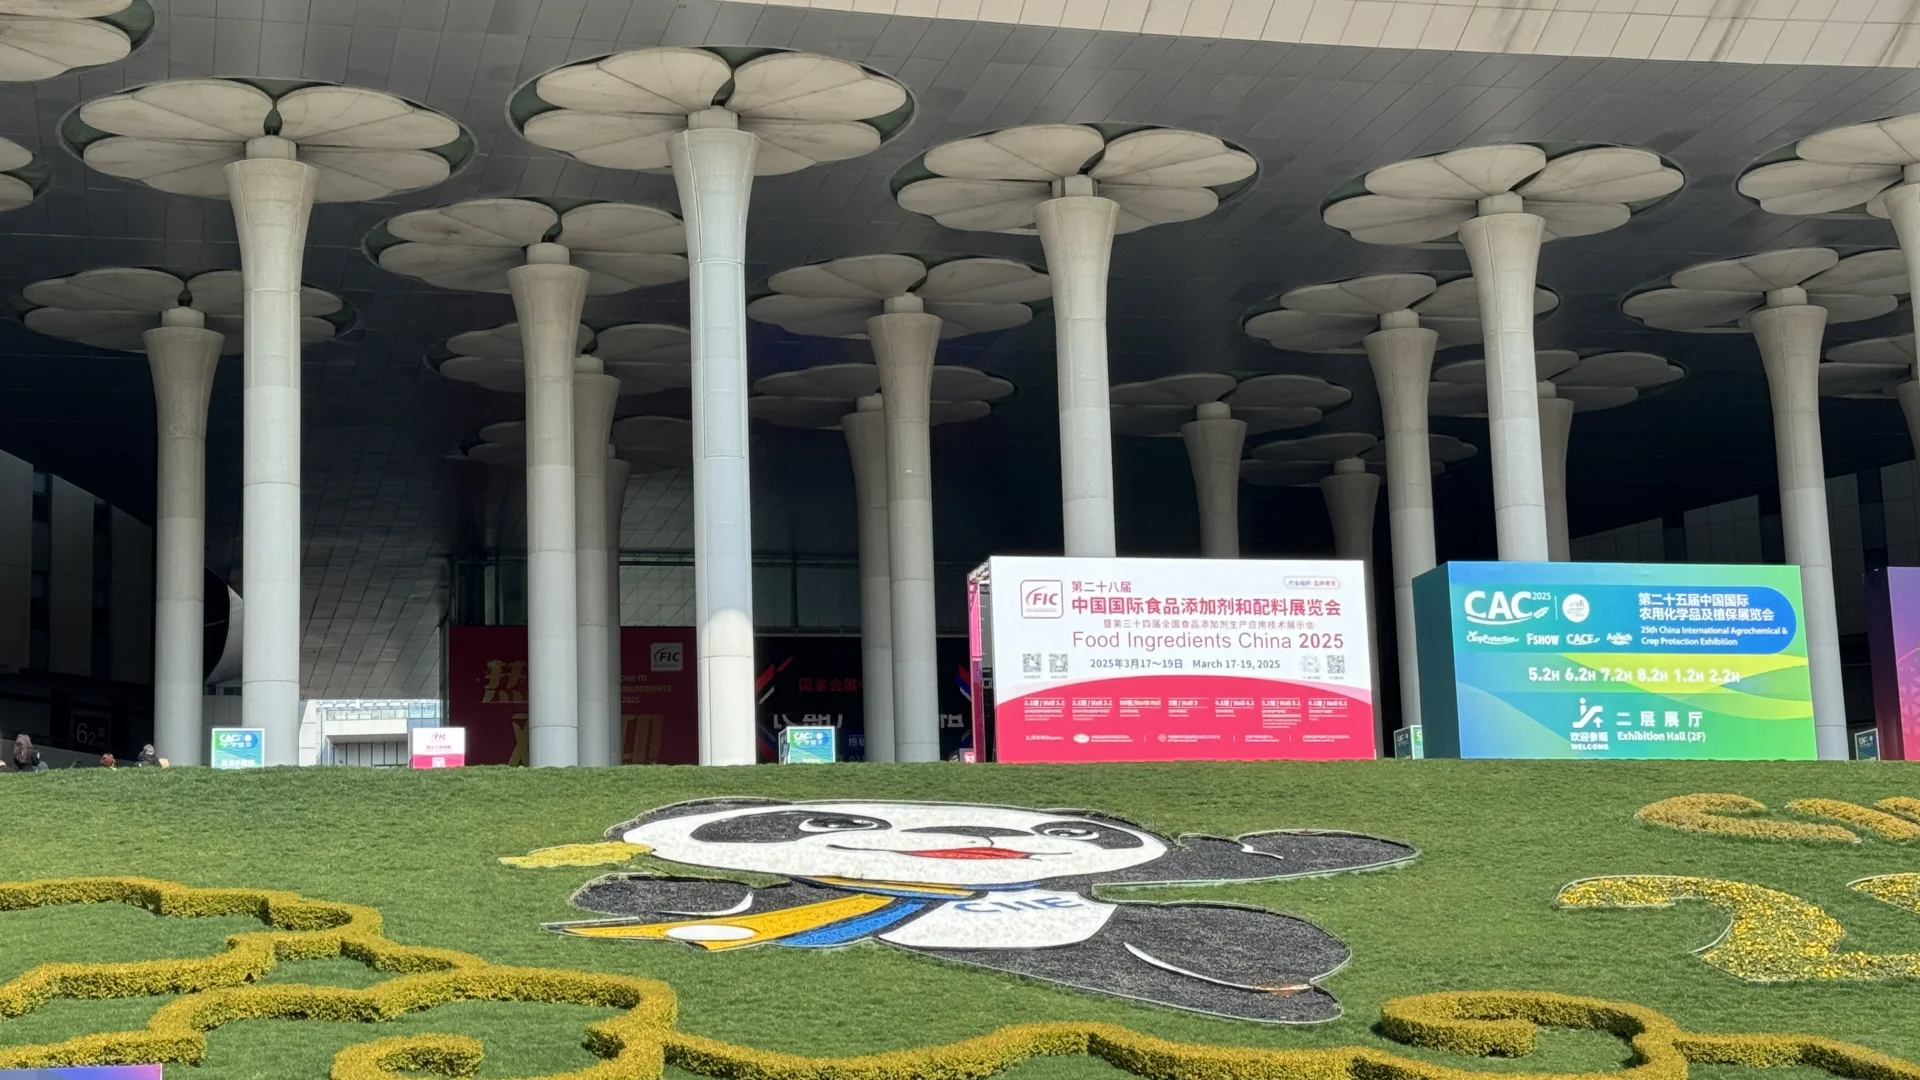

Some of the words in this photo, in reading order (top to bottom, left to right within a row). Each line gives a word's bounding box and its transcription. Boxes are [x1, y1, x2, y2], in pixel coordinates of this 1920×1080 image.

[1072, 581, 1132, 593] 第二十八届
[1032, 593, 1059, 606] FIC
[1464, 590, 1533, 620] CAC
[1532, 592, 1551, 601] 2025
[1638, 592, 1750, 607] 第二十五届中国国际
[1072, 596, 1342, 617] 中国国际食品添加剂和配料展览会
[1639, 607, 1775, 622] 农用化学品及植保展览会
[1640, 626, 1658, 634] 25th
[1659, 626, 1681, 634] China
[1682, 626, 1730, 635] International
[1731, 627, 1779, 637] Agrochemical
[1781, 627, 1788, 635] &
[1073, 631, 1120, 648] Food
[1128, 631, 1232, 652] Ingredients
[1238, 632, 1292, 649] China
[1298, 633, 1344, 649] 2025
[1566, 634, 1594, 645] CACE
[1641, 637, 1659, 647] Crop
[1661, 637, 1699, 646] Protection
[1700, 637, 1738, 646] Exhibition
[659, 651, 680, 662] FIC
[1192, 659, 1223, 669] March
[1225, 660, 1255, 670] 17-19,
[1257, 659, 1281, 669] 2025
[1528, 667, 1560, 681] 5.2H
[1564, 667, 1597, 681] 6.2H
[1600, 668, 1633, 682] 7.2H
[1637, 668, 1668, 682] 8.2H
[1674, 668, 1704, 682] 1.2H
[1709, 669, 1741, 683] 2.2H
[1616, 711, 1703, 728] 二层展厅
[1617, 731, 1665, 741] Exhibition
[1667, 731, 1686, 741] Hall
[1687, 732, 1706, 743] (2F)
[1570, 743, 1609, 751] WELCOME
